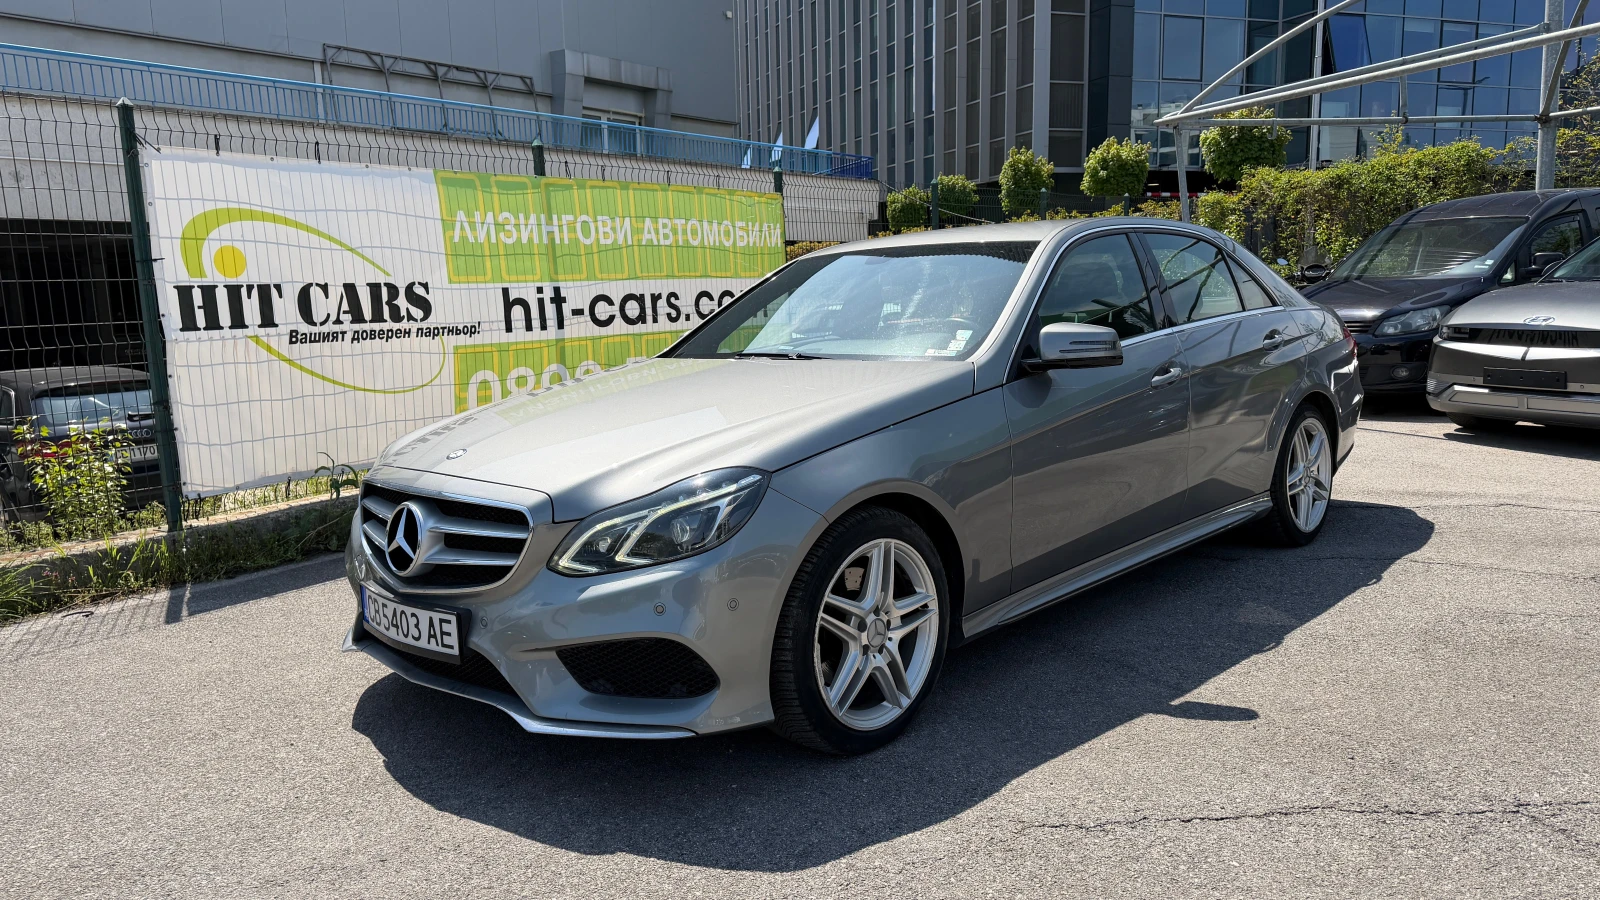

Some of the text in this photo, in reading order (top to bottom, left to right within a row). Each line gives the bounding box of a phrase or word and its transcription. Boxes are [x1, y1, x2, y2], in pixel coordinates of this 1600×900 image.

[453, 210, 782, 248] ЛИЗИНГОВИ АВТОМОБИЛИ
[173, 281, 432, 332] HIT CARS
[288, 321, 481, 345] Вашият доверен партньор!
[427, 615, 455, 650] AE
